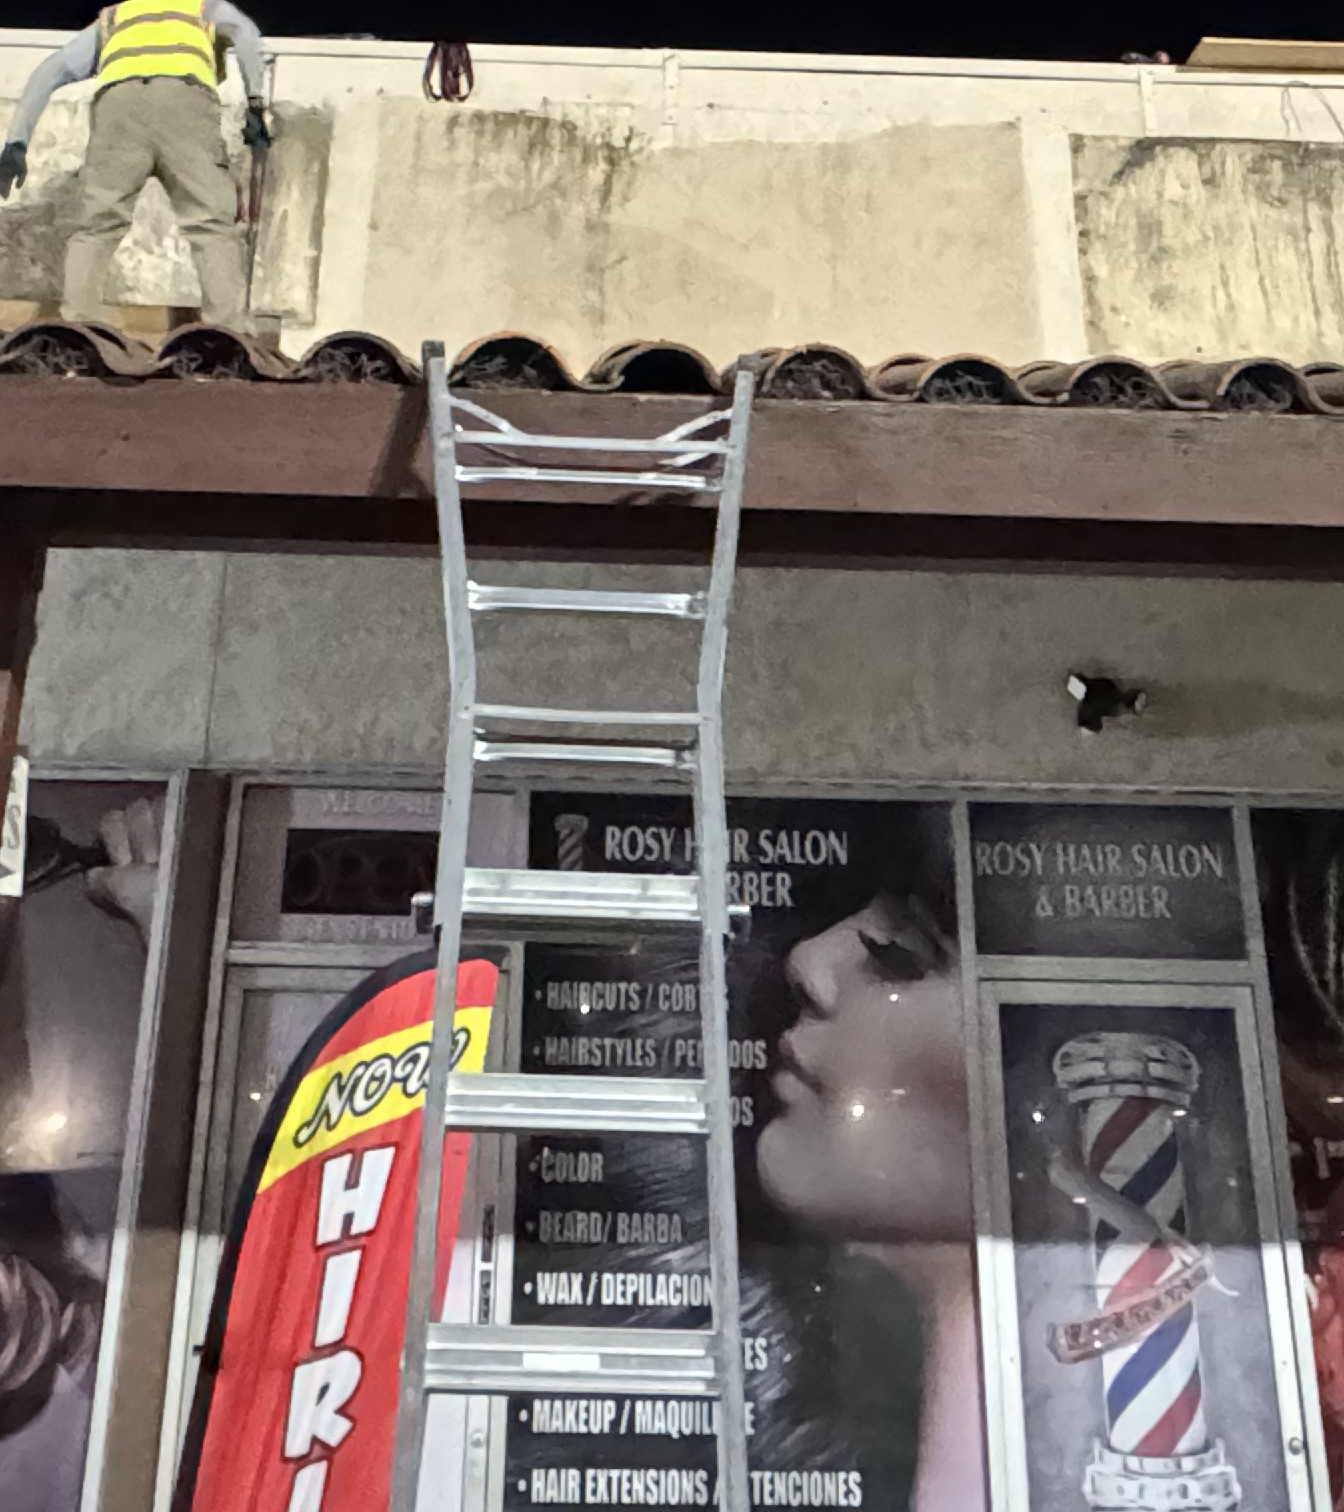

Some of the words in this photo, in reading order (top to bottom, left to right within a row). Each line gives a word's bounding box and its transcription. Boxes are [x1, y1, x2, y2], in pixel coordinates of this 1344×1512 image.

[605, 825, 676, 862] ROSY
[684, 827, 752, 864] HIR
[758, 828, 848, 866] SALON
[975, 841, 1045, 877] ROSY
[1056, 843, 1122, 876] HAIR
[1131, 843, 1224, 879] SALON
[726, 870, 795, 908] RBER
[1034, 888, 1054, 917] &
[1064, 884, 1172, 920] BARBER
[546, 980, 641, 1012] HAIRCUTS
[544, 1036, 656, 1068] HAIRSTYLES
[674, 1038, 767, 1070] PEIDOS
[293, 1026, 471, 1148] NOW
[541, 1150, 604, 1183] COLOR
[616, 1212, 683, 1244] BARBA
[536, 1271, 584, 1306] WAX
[532, 1399, 617, 1435] MAKEUP
[634, 1399, 755, 1439] MAQUILLE
[530, 1468, 581, 1504] HAIR
[585, 1468, 709, 1506] EXTENSIONS
[750, 1470, 863, 1508] TENCIONES
